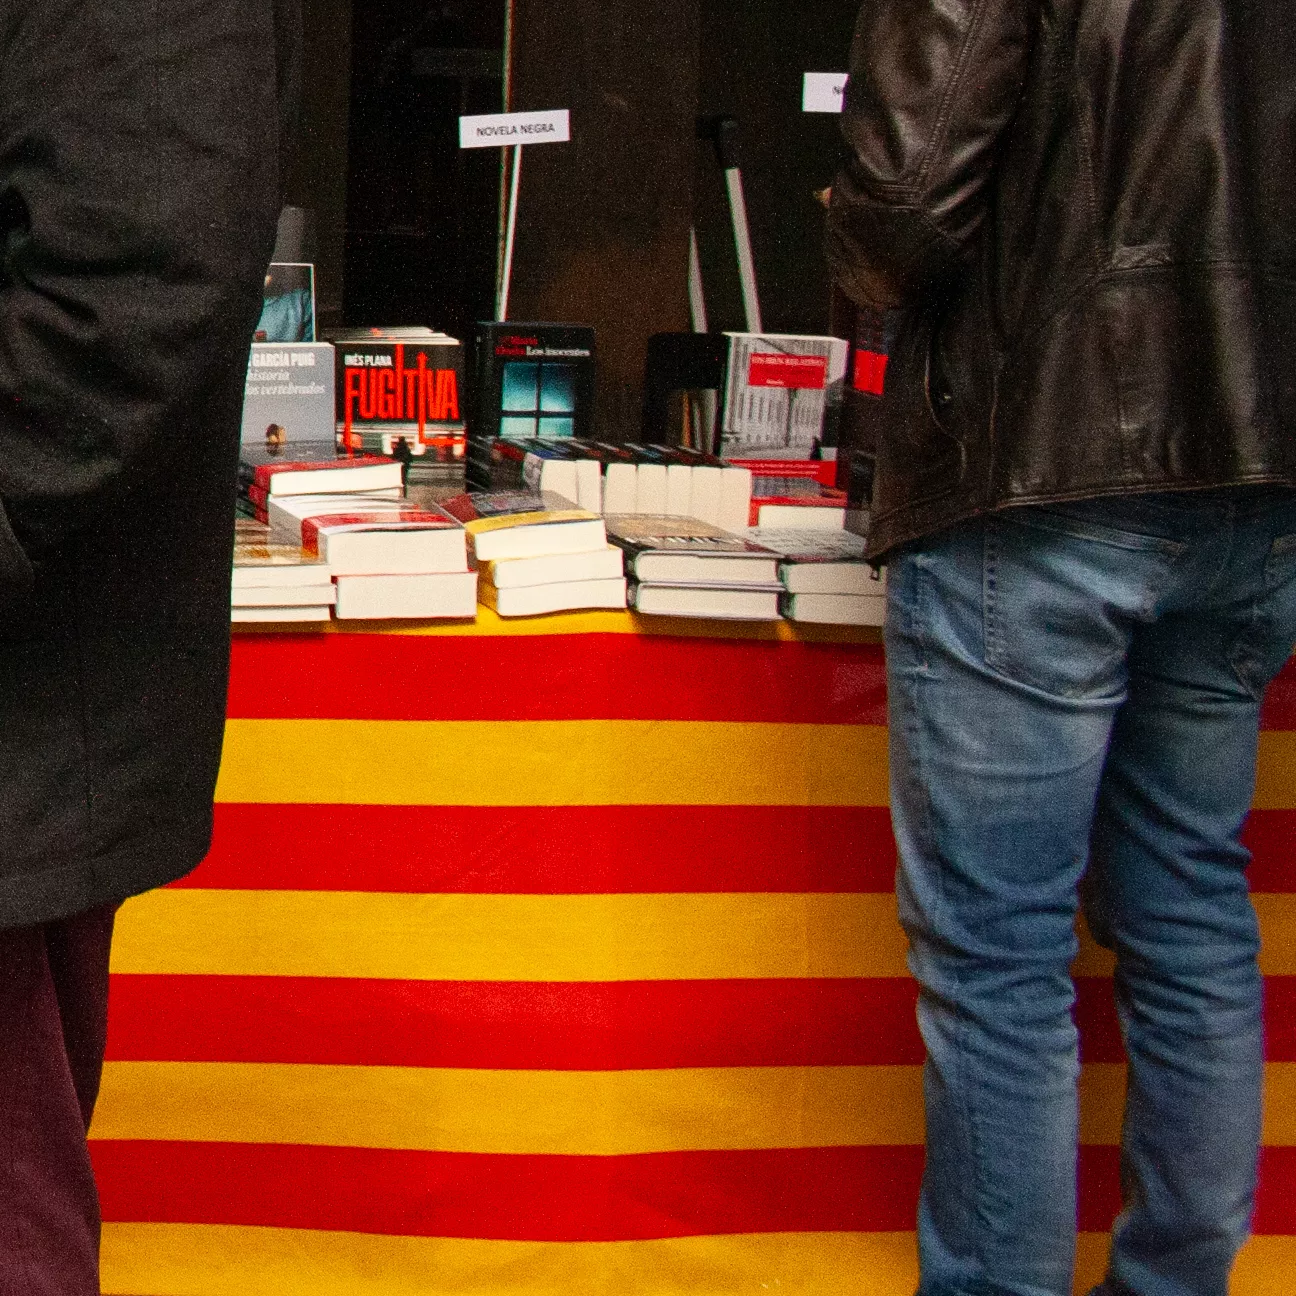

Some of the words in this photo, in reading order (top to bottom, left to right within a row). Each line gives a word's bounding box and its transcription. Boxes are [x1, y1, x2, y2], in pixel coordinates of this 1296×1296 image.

[476, 124, 519, 137] NOVELA
[520, 122, 556, 135] NEGRA
[344, 344, 461, 423] FUGITIVA
